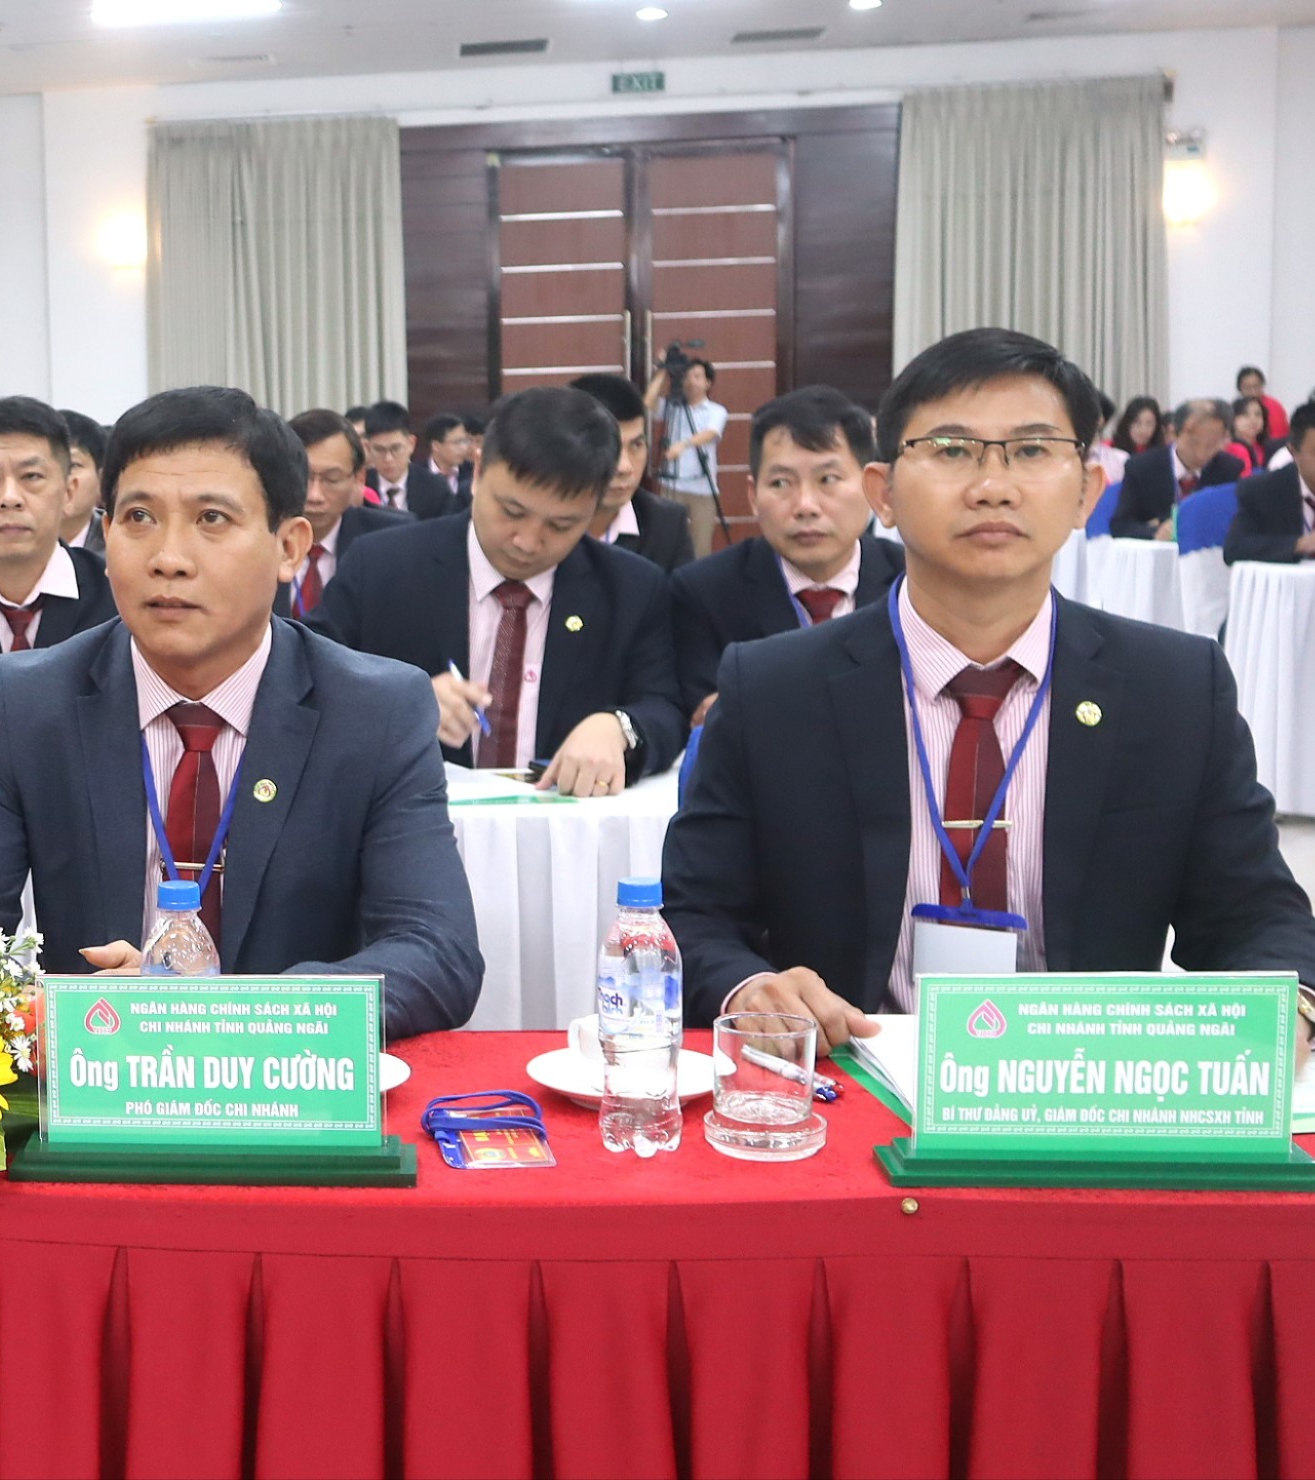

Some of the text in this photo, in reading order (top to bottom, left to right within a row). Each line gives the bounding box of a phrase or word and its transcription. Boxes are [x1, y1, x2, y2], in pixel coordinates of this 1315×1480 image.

[618, 73, 657, 92] EXIT
[130, 1001, 338, 1019] NGÂN HÀNG CHÍNH SÁCH XÃ HỘI
[1018, 1001, 1247, 1019] NGÂN HÀNG CHÍNH SÁCH XÃ HỘI
[139, 1018, 329, 1035] CHI NHÁNH TỈNH QUẢNG NGÃI
[1027, 1019, 1236, 1037] CHI NHÁNH TỈNH QUẢNG NGÃI
[70, 1044, 354, 1092] Ông TRẦN DUY CƯỜNG
[939, 1047, 1270, 1103] Ông NGUYỄN NGỌC TUẤN
[125, 1098, 299, 1118] PHÓ GIÁM ĐỐC CHI NHÁNH
[943, 1105, 956, 1121] BÍ
[958, 1106, 983, 1121] THƯ
[985, 1104, 1018, 1122] ĐẢNG
[1044, 1106, 1078, 1122] GIÁM
[1079, 1106, 1106, 1123] ĐỐC
[1108, 1108, 1130, 1123] CHI
[1132, 1107, 1177, 1124] NHÁNH
[1179, 1109, 1232, 1124] NHCSXH
[1234, 1106, 1264, 1125] TỈNH
